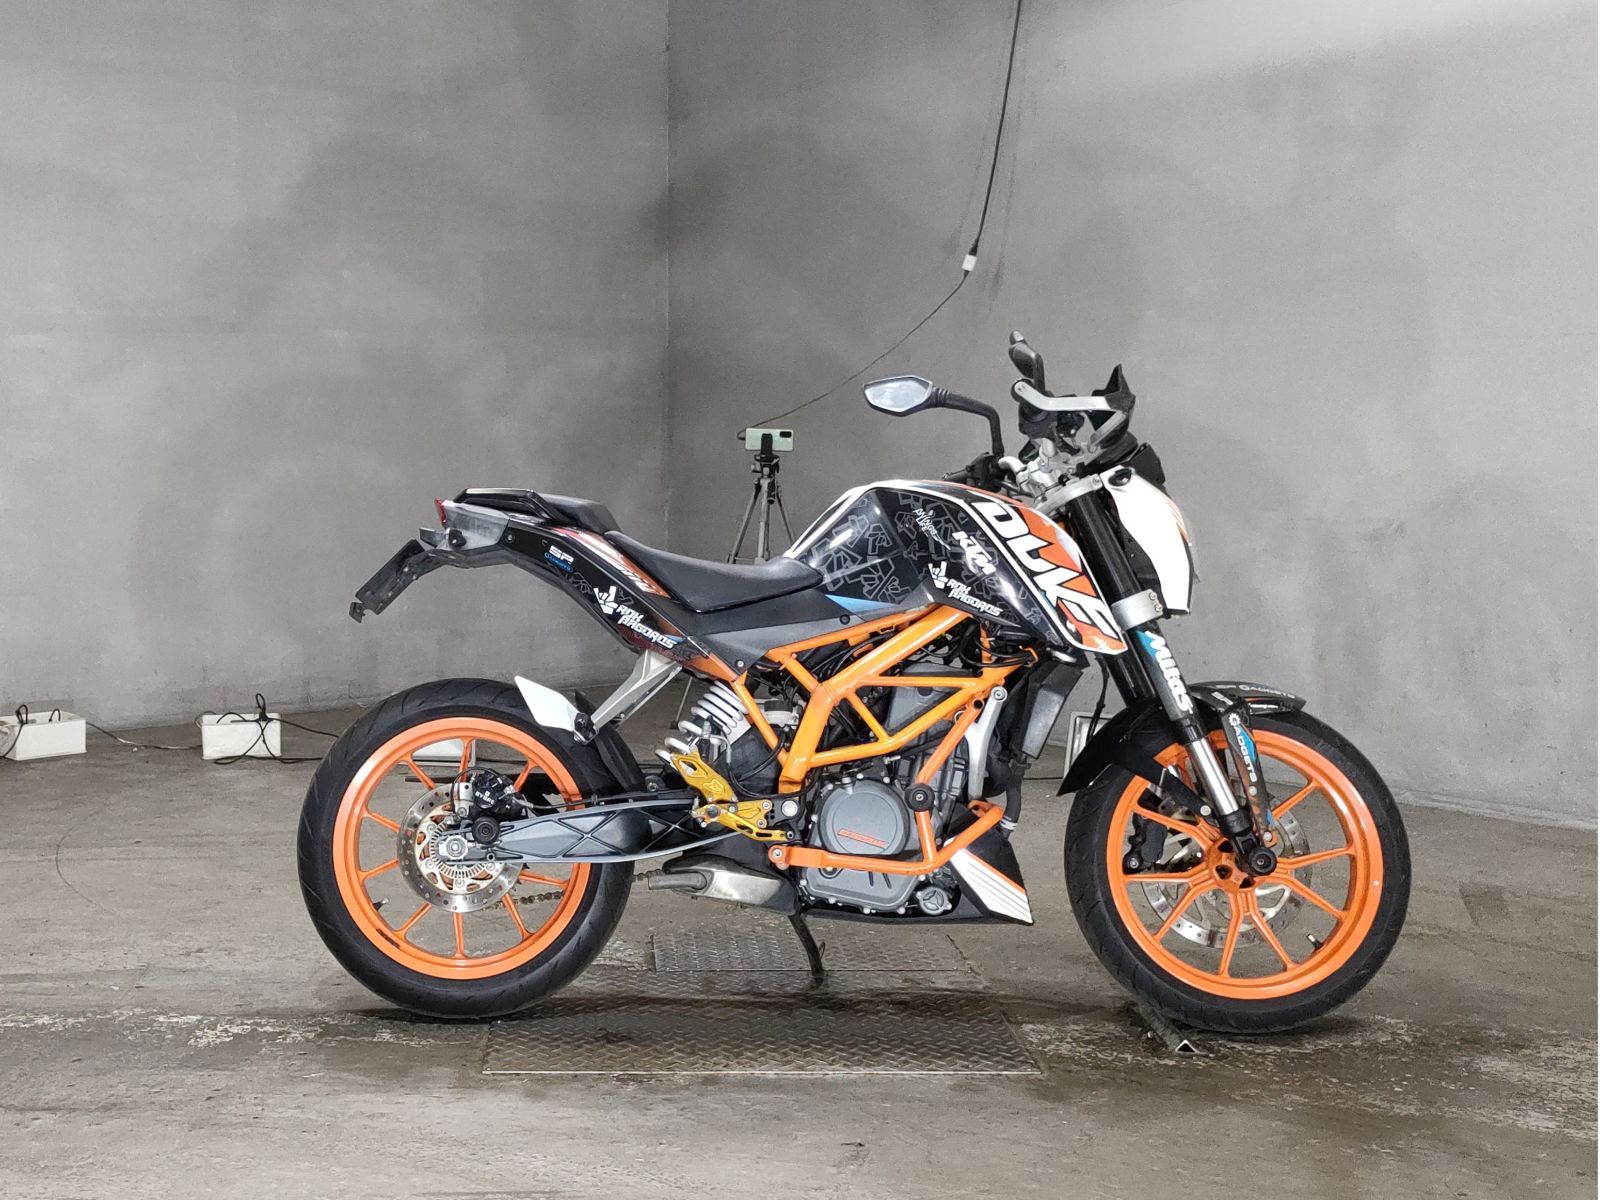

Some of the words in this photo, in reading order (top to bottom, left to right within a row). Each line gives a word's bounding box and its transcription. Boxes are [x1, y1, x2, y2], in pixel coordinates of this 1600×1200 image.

[952, 531, 997, 576] KTM
[971, 502, 1120, 641] DUKE
[947, 578, 972, 595] ROK
[616, 604, 645, 622] ROK
[1228, 712, 1258, 782] GADGETS
